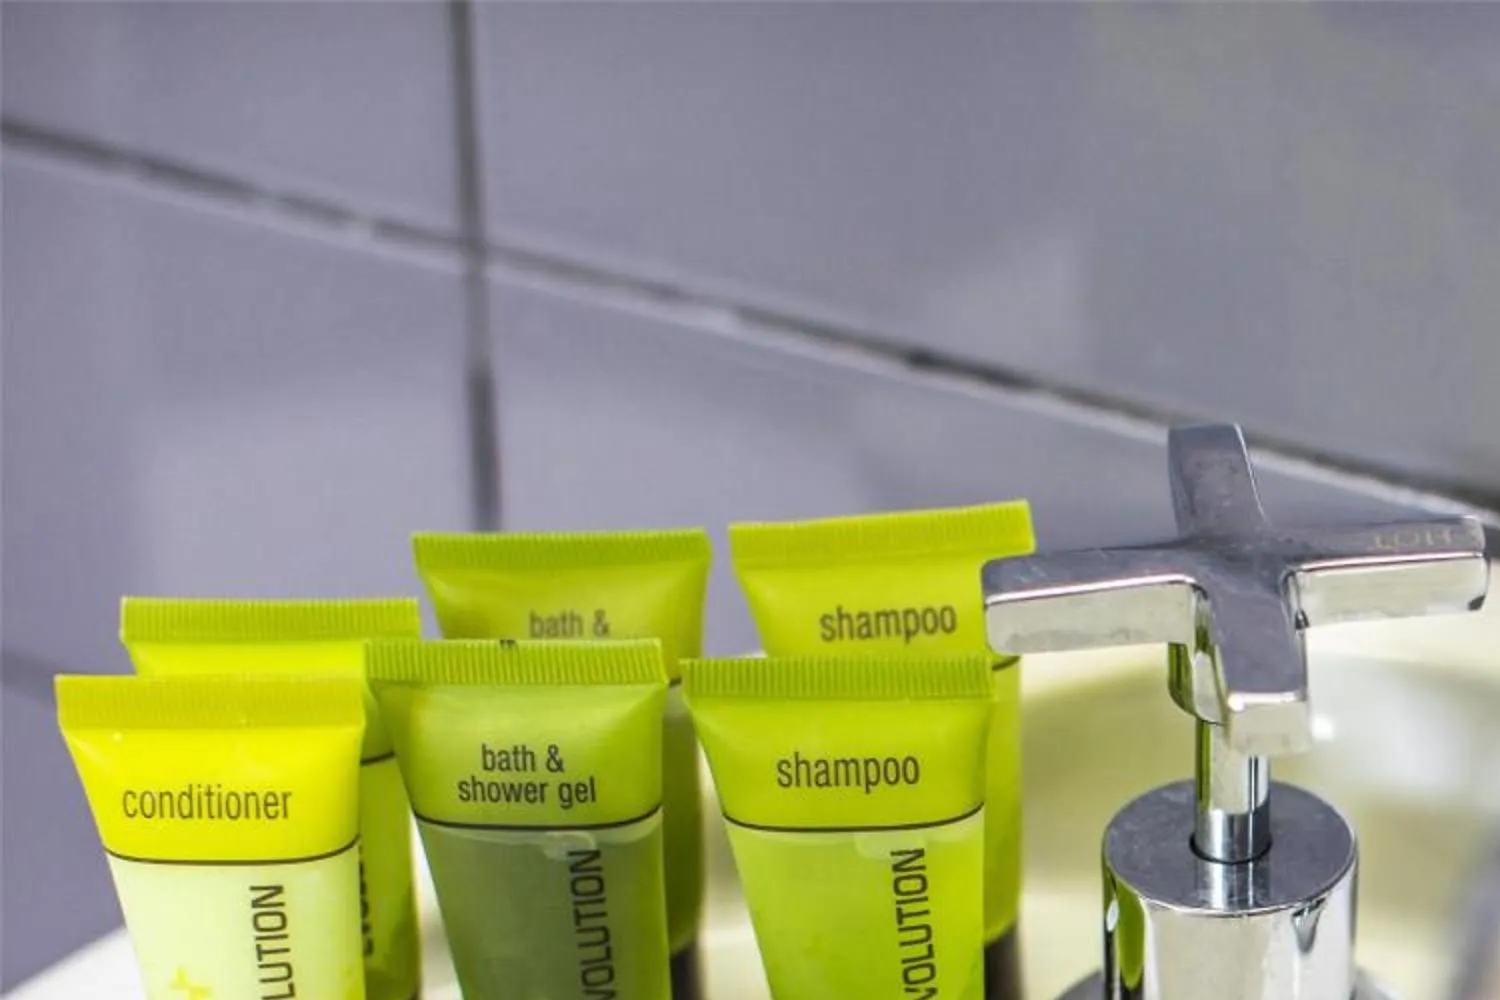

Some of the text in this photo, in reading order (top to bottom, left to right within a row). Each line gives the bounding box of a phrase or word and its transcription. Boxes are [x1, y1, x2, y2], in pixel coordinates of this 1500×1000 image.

[529, 607, 611, 638] bath &
[820, 603, 957, 643] shampoo
[481, 745, 564, 773] bath &
[777, 752, 920, 794] shampoo
[122, 783, 293, 820] conditioner
[458, 777, 596, 809] shower gel
